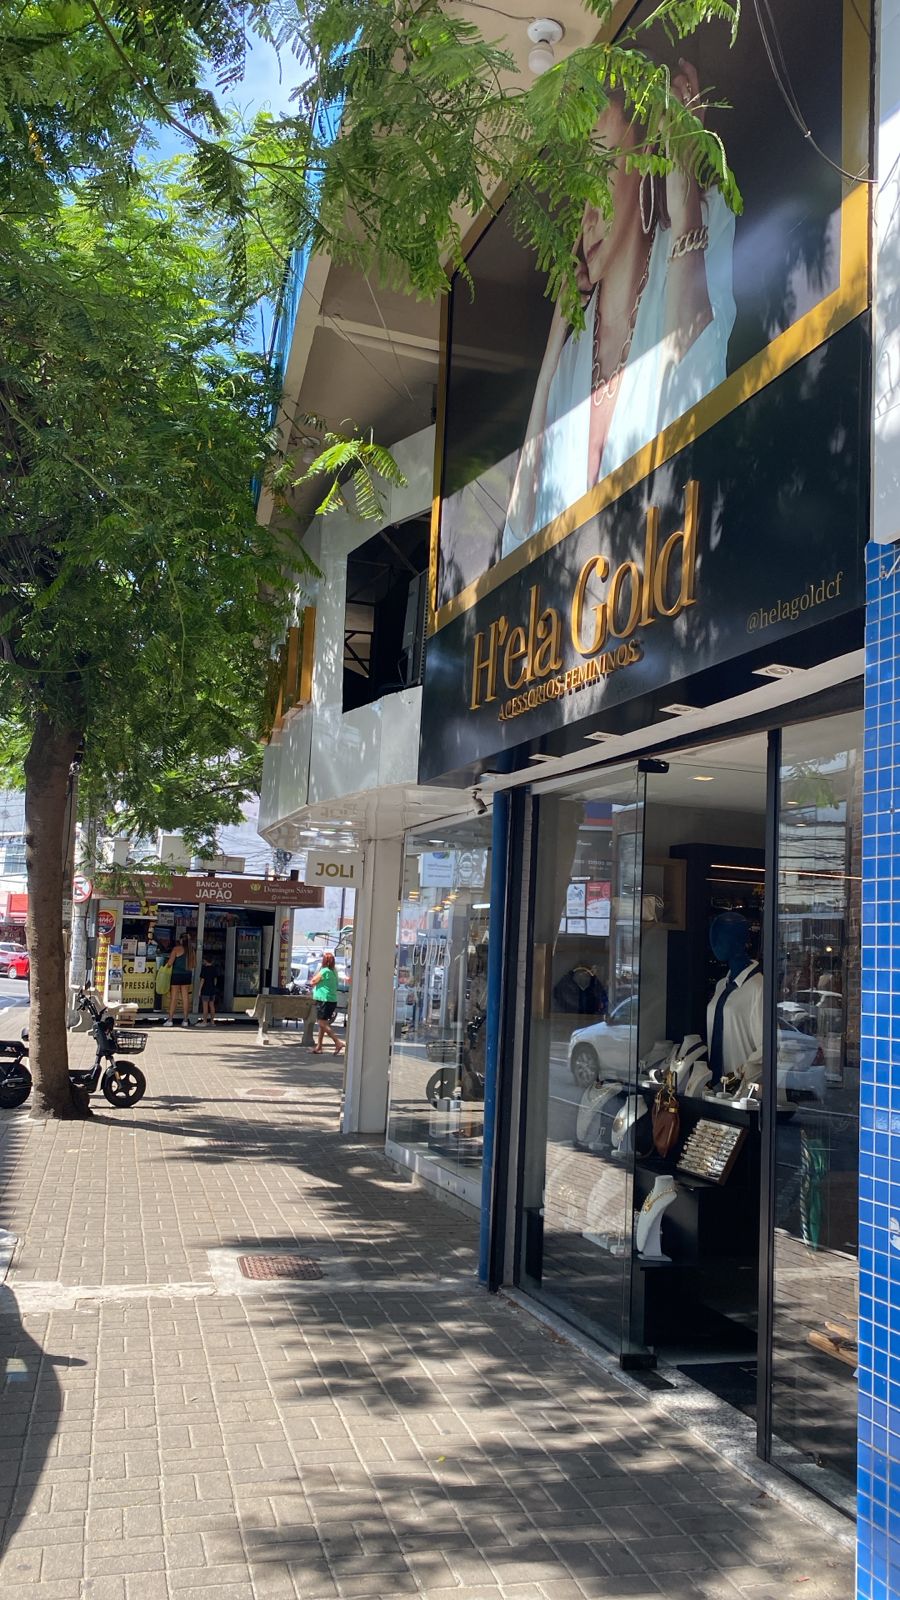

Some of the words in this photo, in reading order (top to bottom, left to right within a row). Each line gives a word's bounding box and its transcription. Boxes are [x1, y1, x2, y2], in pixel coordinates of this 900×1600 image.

[571, 479, 700, 658] Gold
[746, 571, 844, 634] @helagoldcf
[564, 639, 641, 692] FEMININOS
[195, 888, 233, 900] JAPÃO
[315, 862, 354, 879] JOLI
